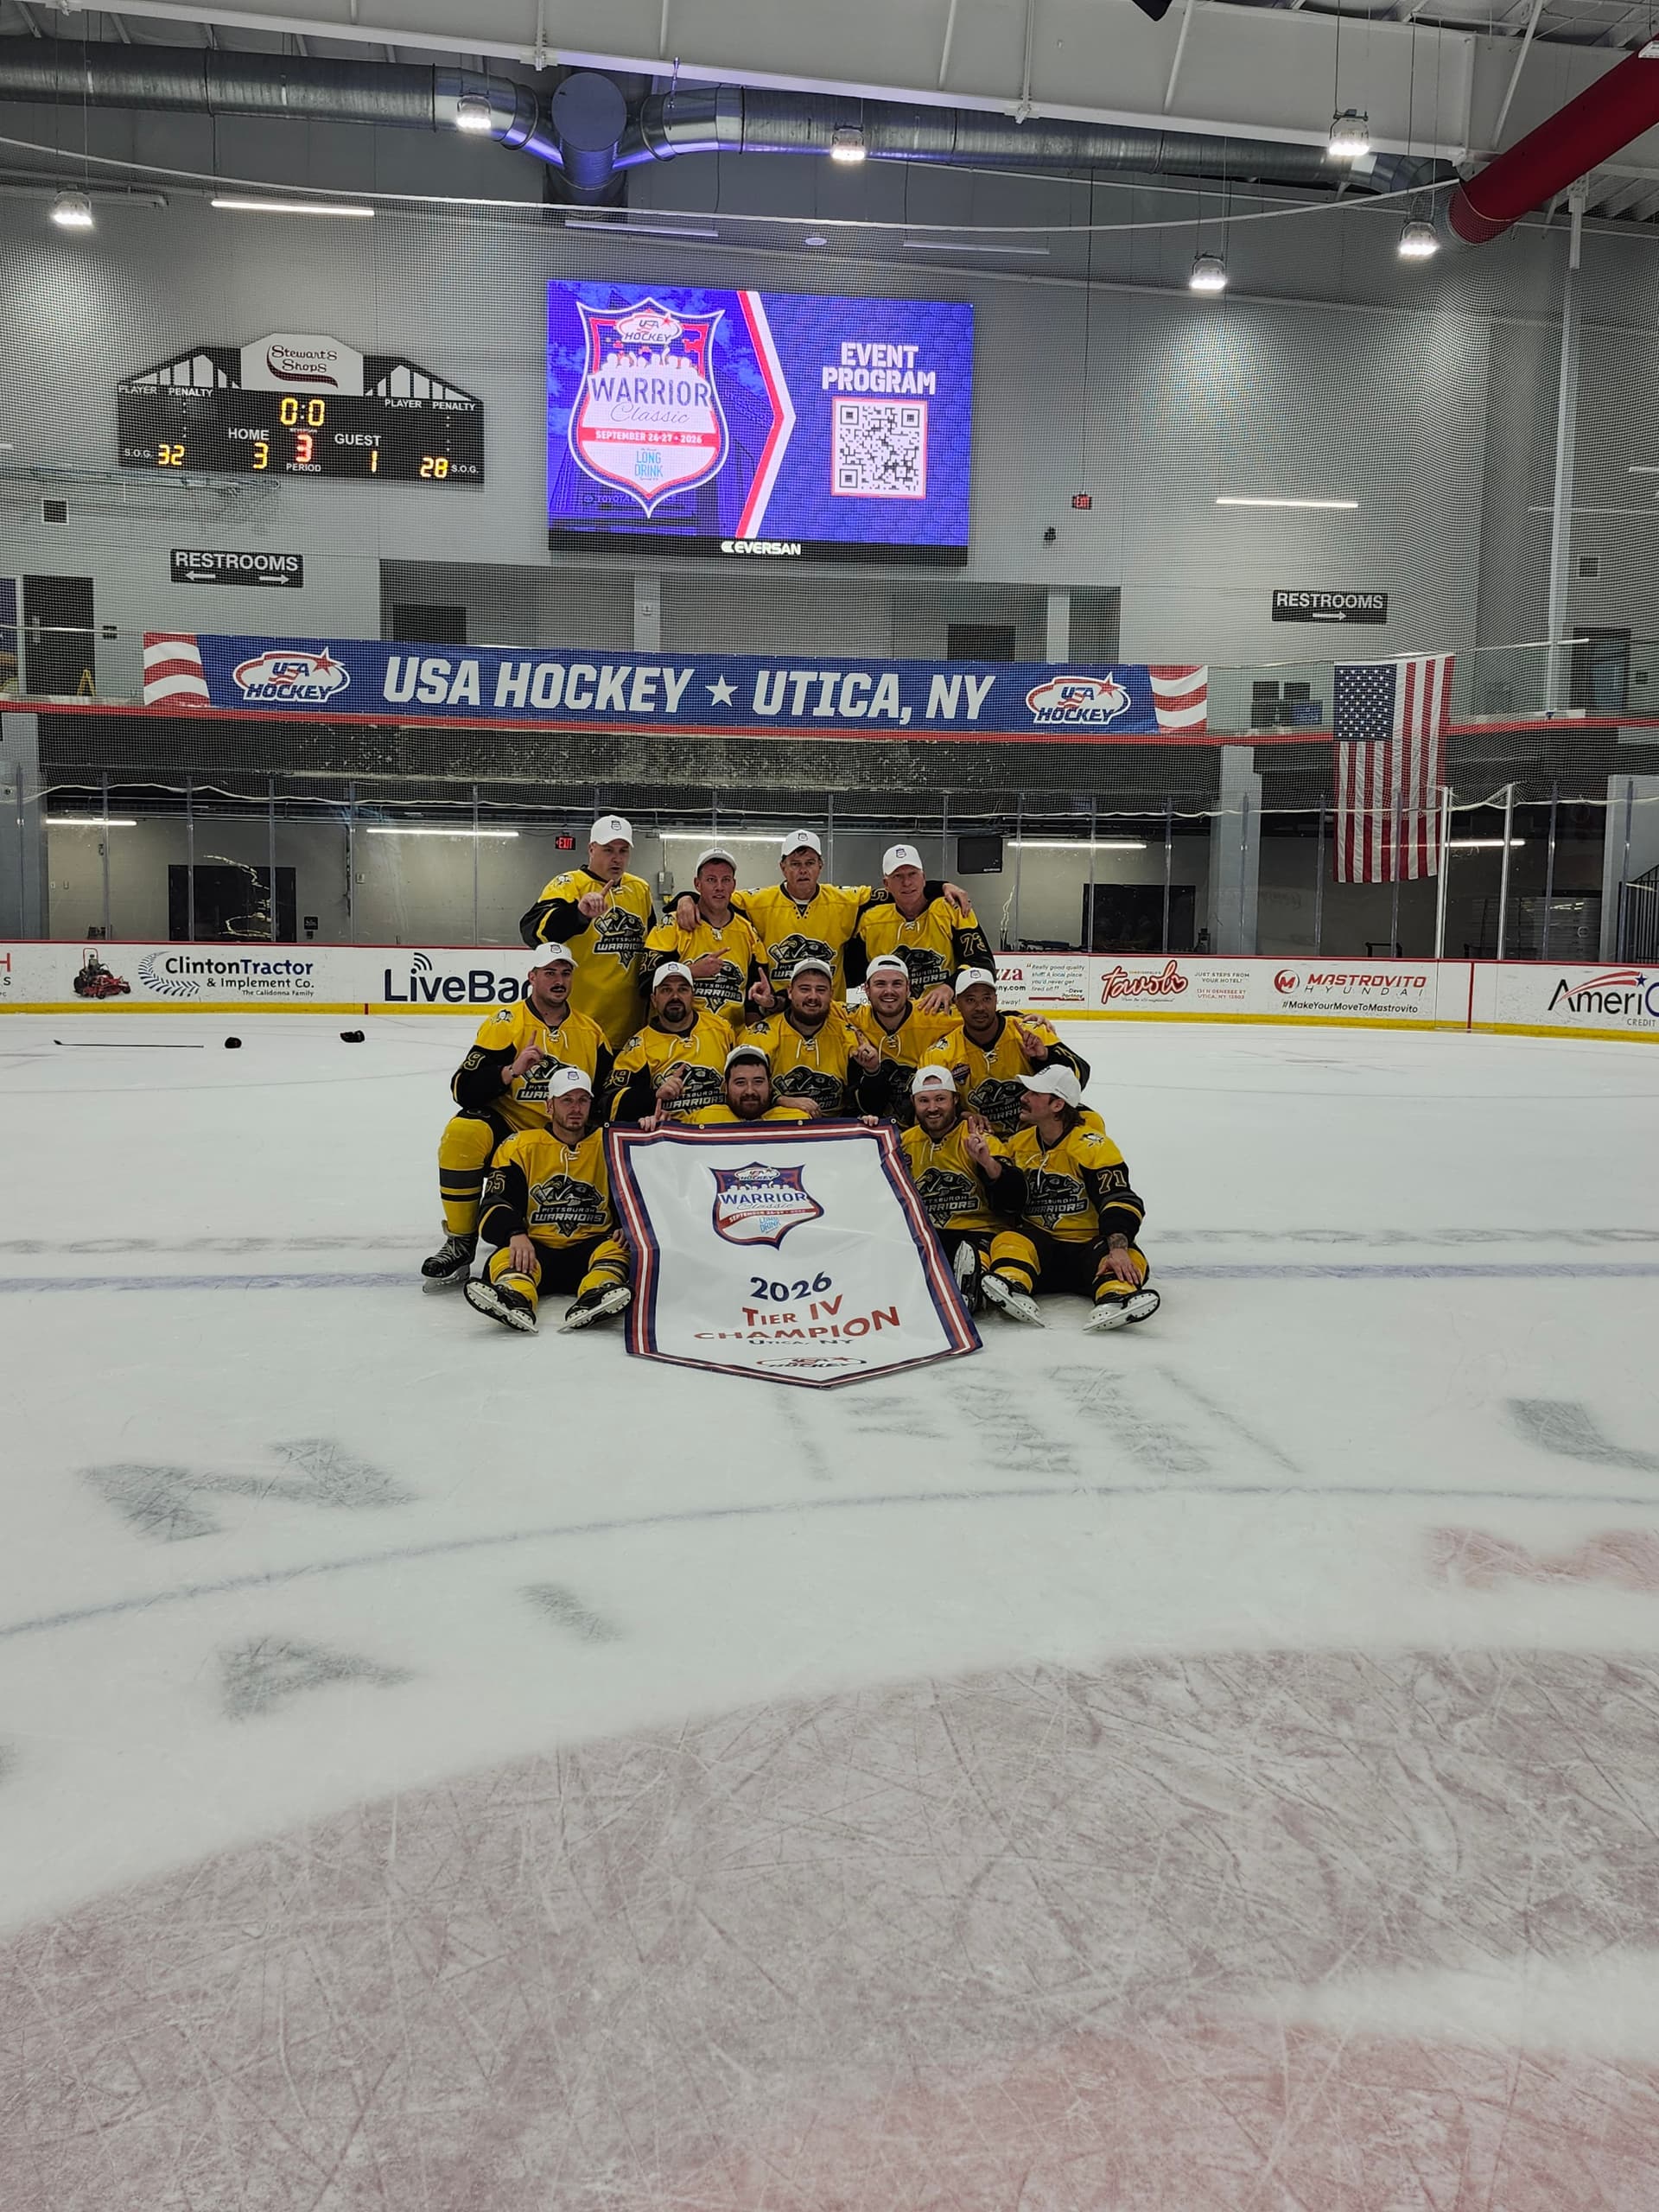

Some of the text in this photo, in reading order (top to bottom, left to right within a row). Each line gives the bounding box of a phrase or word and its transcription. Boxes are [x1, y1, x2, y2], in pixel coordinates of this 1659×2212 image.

[625, 332, 671, 342] HOCKEY
[841, 341, 918, 369] EVENT
[822, 367, 936, 395] PROGRAM
[118, 385, 213, 397] PLAYER PENALTY
[591, 377, 709, 407] WARRIOR
[385, 399, 475, 411] PLAYER PENALTY
[610, 401, 690, 423] Classic
[228, 427, 270, 441] HOME
[334, 433, 382, 446] GUEST
[595, 430, 645, 441] SEPTEMBER
[680, 435, 702, 444] 2026
[124, 448, 154, 459] S.O.G.
[157, 444, 185, 466] 32
[296, 434, 313, 462] 3
[252, 442, 269, 469] 3
[371, 450, 378, 473] 1
[636, 450, 661, 464] LONG
[286, 462, 321, 472] PERIOD
[420, 457, 448, 479] 28
[450, 464, 479, 474] S.O.G.
[634, 463, 664, 477] DRINK
[734, 541, 801, 556] EVERSAN
[175, 551, 299, 571] RESTROOMS
[1276, 592, 1383, 609] RESTROOMS
[246, 683, 333, 700] HOCKEY
[383, 656, 695, 714] USA HOCKEY
[752, 670, 996, 725] UTICA, NY
[1036, 707, 1115, 721] HOCKEY
[558, 837, 574, 849] EXIT
[165, 956, 314, 975] ClintonTractor
[911, 972, 947, 985] RIORS
[995, 968, 1023, 982] zza
[1307, 973, 1427, 988] MASTROVITO
[207, 977, 315, 990] & Implement Co.
[693, 988, 741, 1001] ARRIORS
[1304, 986, 1423, 996] HYUNDAI
[1281, 1000, 1418, 1014] #MakeYourMoveToMastrovito
[1626, 1018, 1656, 1027] CREDIT
[663, 1096, 724, 1109] WARRIORS
[1096, 1169, 1128, 1194] 71
[721, 1192, 806, 1205] WARRIOR
[926, 1200, 976, 1212] RRIORS
[535, 1212, 603, 1222] WARRIORS
[760, 1220, 780, 1233] DRINK
[750, 1271, 832, 1302] 2026
[810, 1294, 843, 1320] IV
[694, 1306, 900, 1339] CHAMPION
